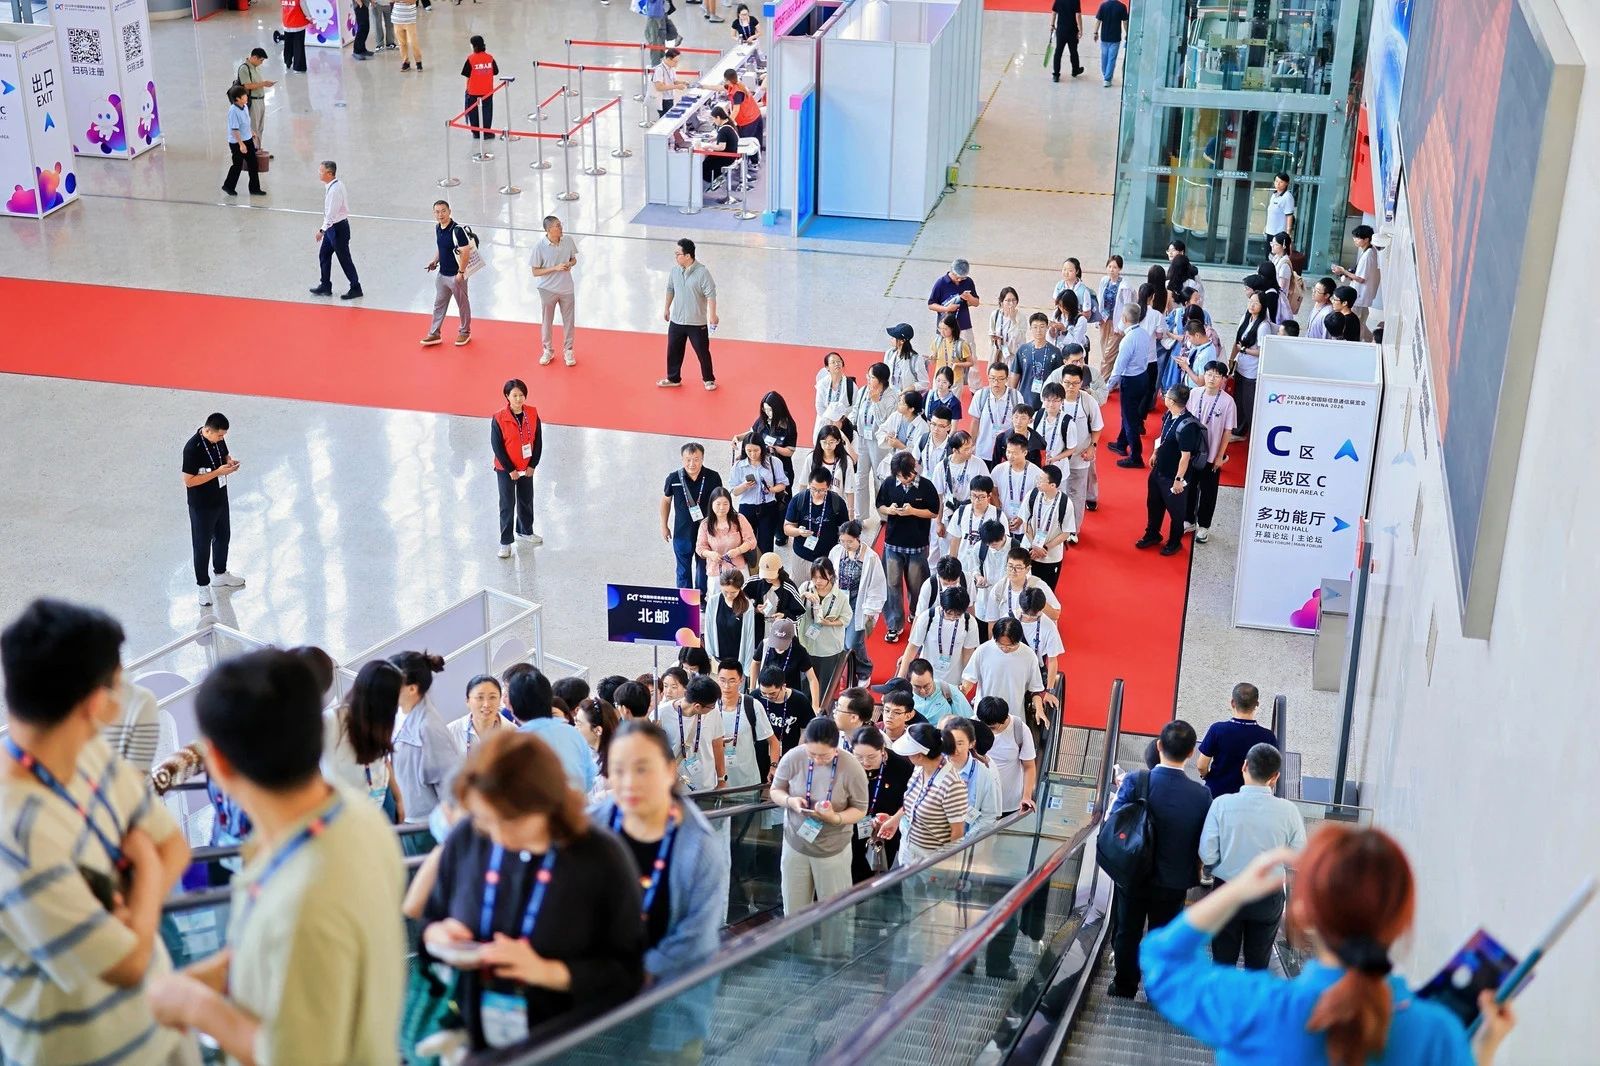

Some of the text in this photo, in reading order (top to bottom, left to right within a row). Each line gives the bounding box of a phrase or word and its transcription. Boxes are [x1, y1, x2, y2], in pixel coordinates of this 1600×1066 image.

[72, 66, 104, 76] 扫码注册
[32, 69, 54, 93] 出口
[37, 90, 53, 107] EXIT
[1266, 426, 1315, 460] C 区
[1260, 469, 1327, 488] 展览区 C
[1259, 486, 1299, 494] EXHIBITION
[1257, 506, 1326, 526] 多功能厅
[1297, 534, 1323, 544] 主论坛
[638, 608, 669, 624] 北邮
